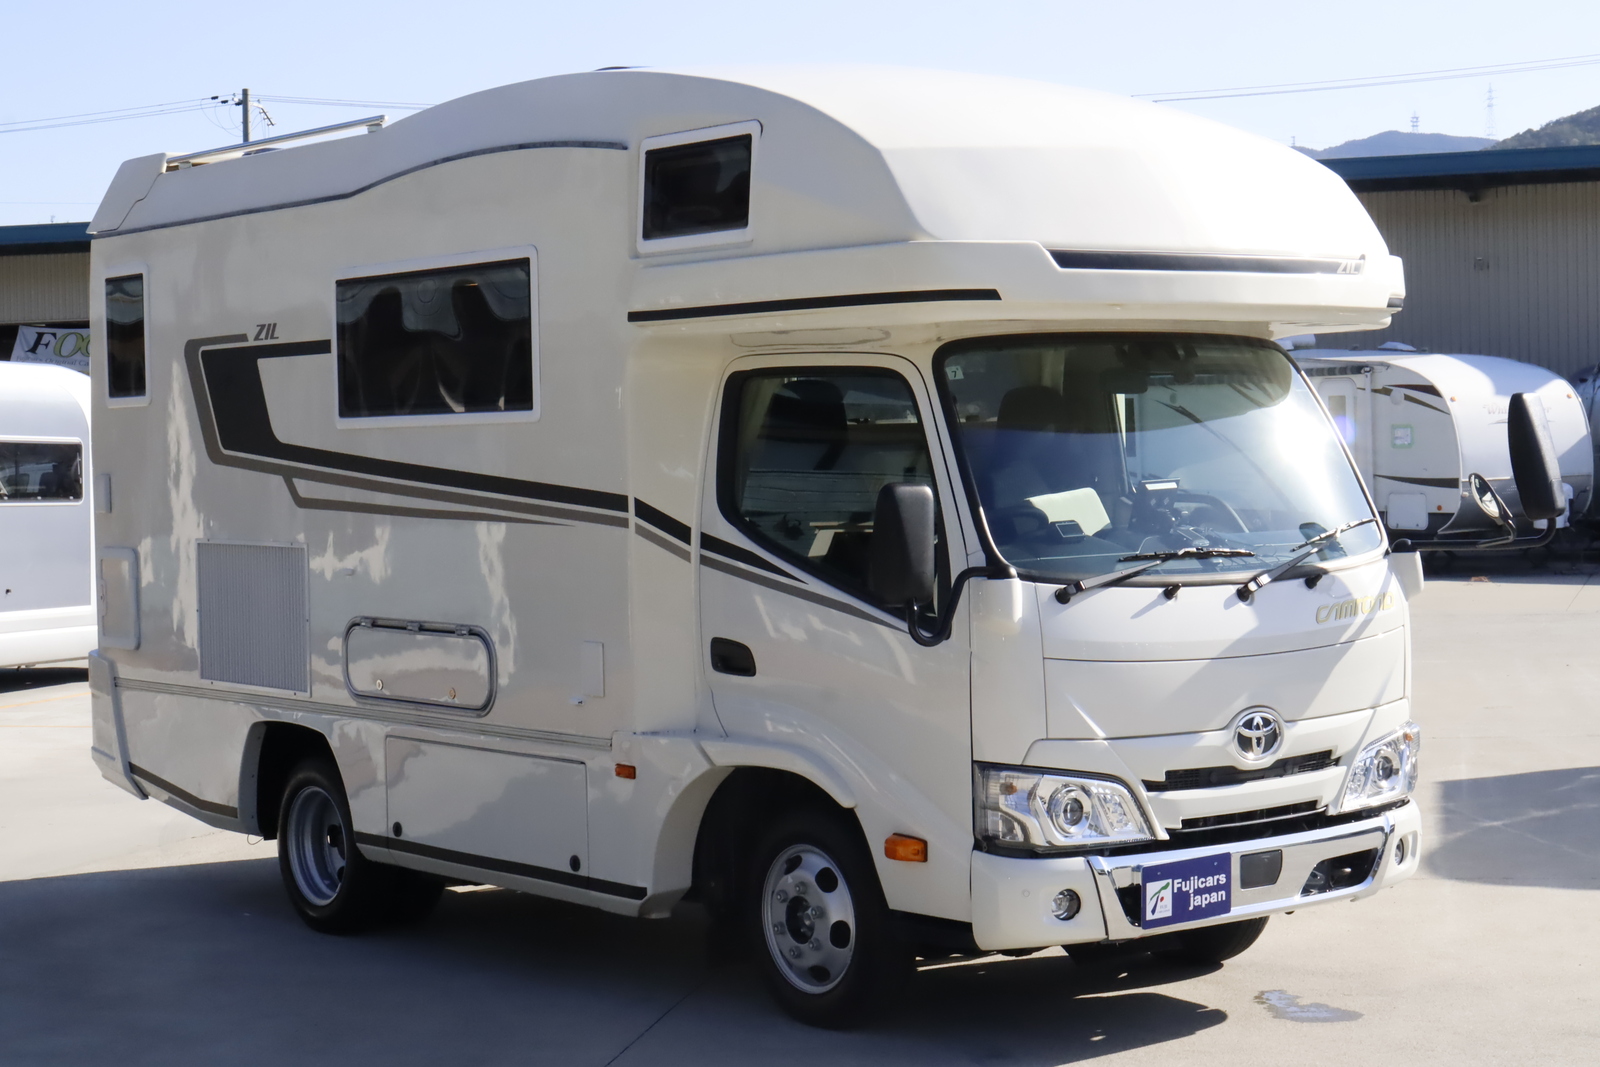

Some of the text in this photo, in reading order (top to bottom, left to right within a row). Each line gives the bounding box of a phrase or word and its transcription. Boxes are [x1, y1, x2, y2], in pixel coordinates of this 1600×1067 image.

[1336, 262, 1359, 274] ZIL
[253, 322, 279, 341] ZIL
[1173, 873, 1226, 893] Fujicars
[1188, 890, 1226, 910] japan
